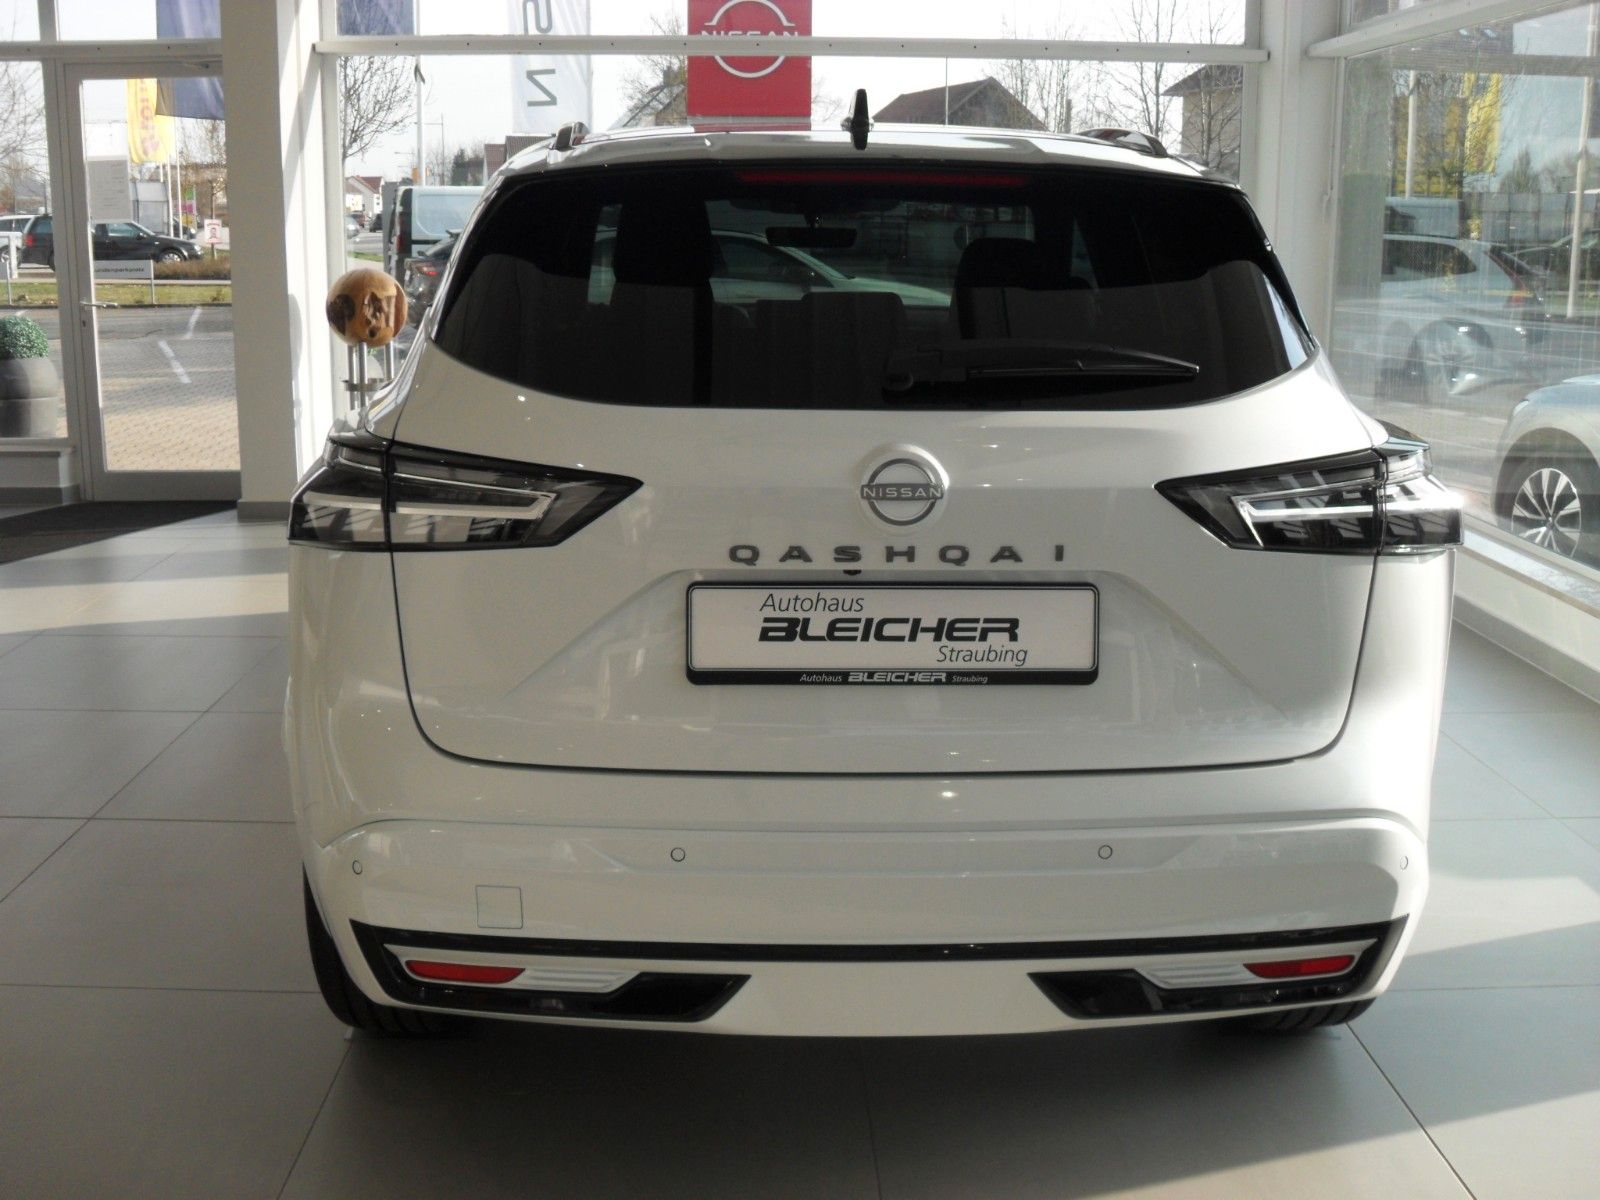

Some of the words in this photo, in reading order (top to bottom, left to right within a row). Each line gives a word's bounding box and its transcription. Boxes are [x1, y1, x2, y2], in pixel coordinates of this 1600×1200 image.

[863, 487, 942, 498] NISSAN
[729, 544, 1064, 566] QASHQAI
[759, 592, 864, 613] Autohaus
[758, 617, 1020, 642] BLEICHER
[936, 644, 1028, 667] Straubing
[799, 673, 843, 683] Autohaus
[848, 672, 947, 683] BLEICHER
[951, 675, 989, 684] Straubing
